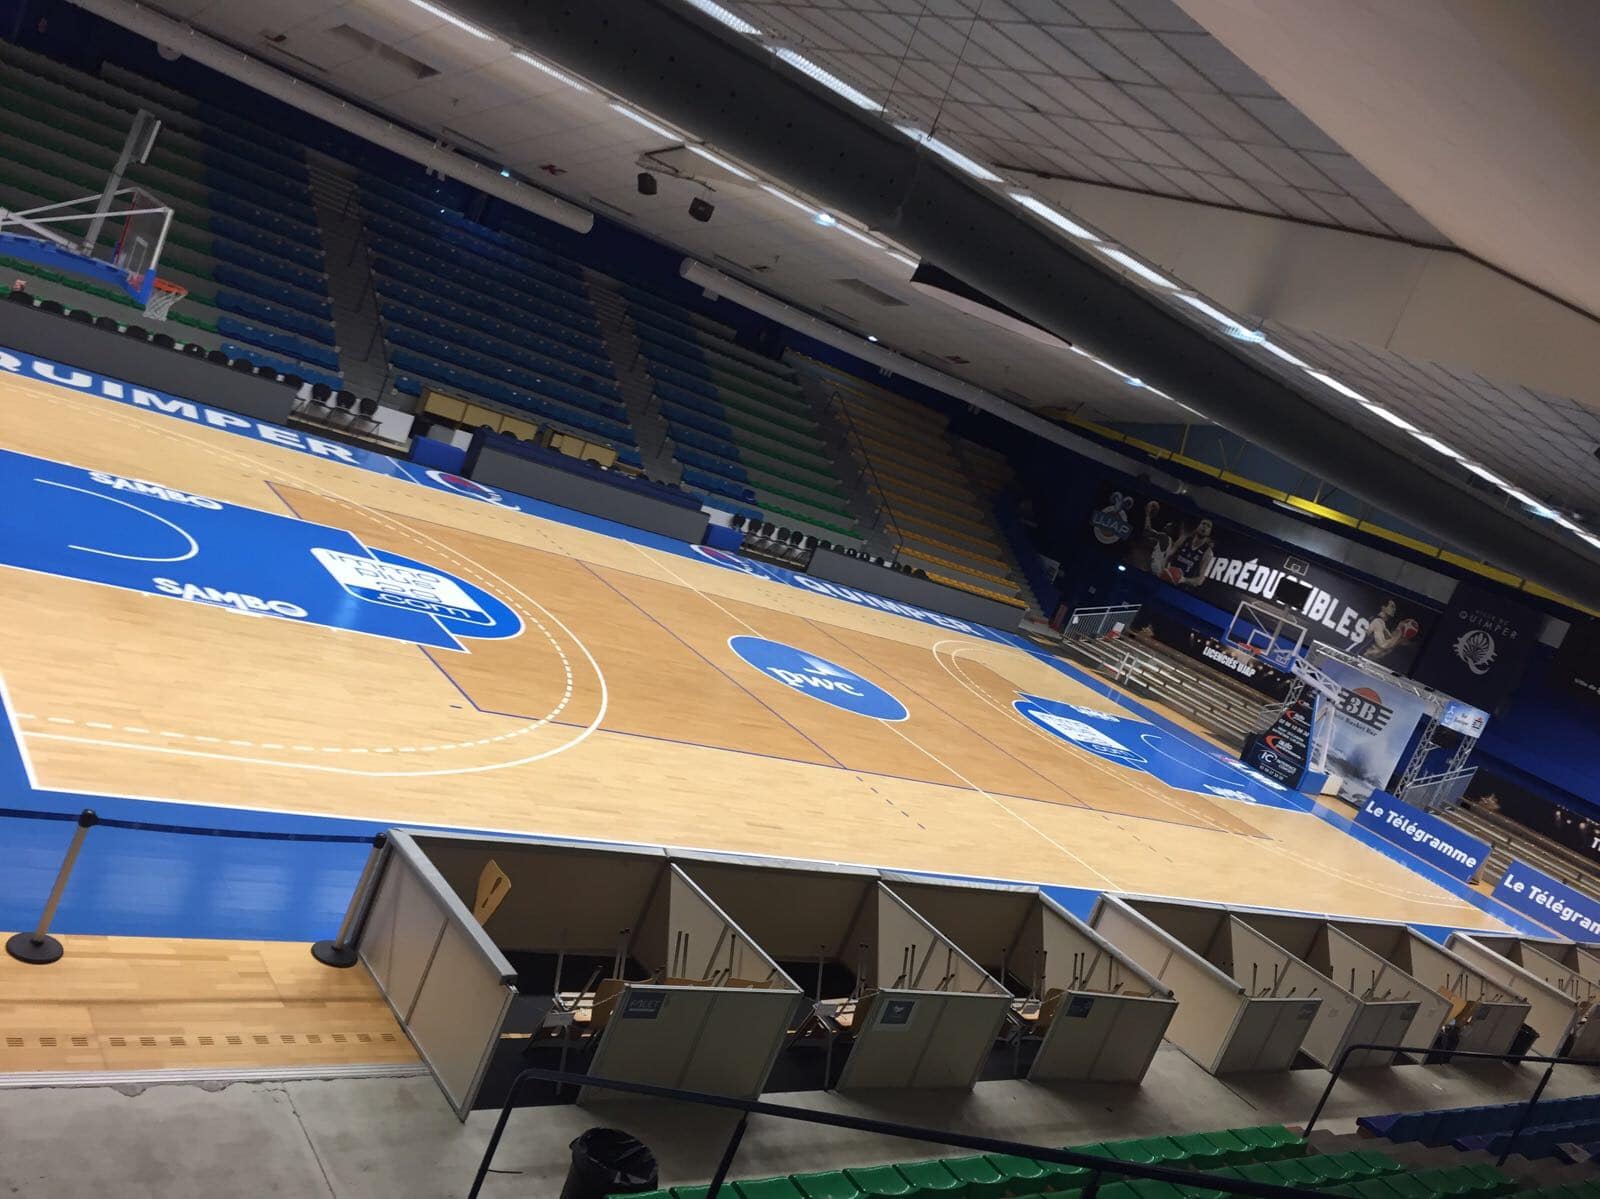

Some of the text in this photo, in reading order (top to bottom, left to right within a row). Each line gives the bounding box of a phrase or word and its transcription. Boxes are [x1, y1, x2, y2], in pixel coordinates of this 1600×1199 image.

[88, 472, 223, 510] SAMBO
[152, 577, 309, 617] SAMBO
[793, 574, 985, 637] QUIMPER
[1204, 556, 1370, 645] IRRÉDUIBLES
[1458, 610, 1519, 640] QUIMPER
[1203, 646, 1239, 670] LICENCIÉS
[766, 666, 865, 697] pwc
[1365, 801, 1477, 868] Le Télégramme
[1503, 874, 1525, 893] Le
